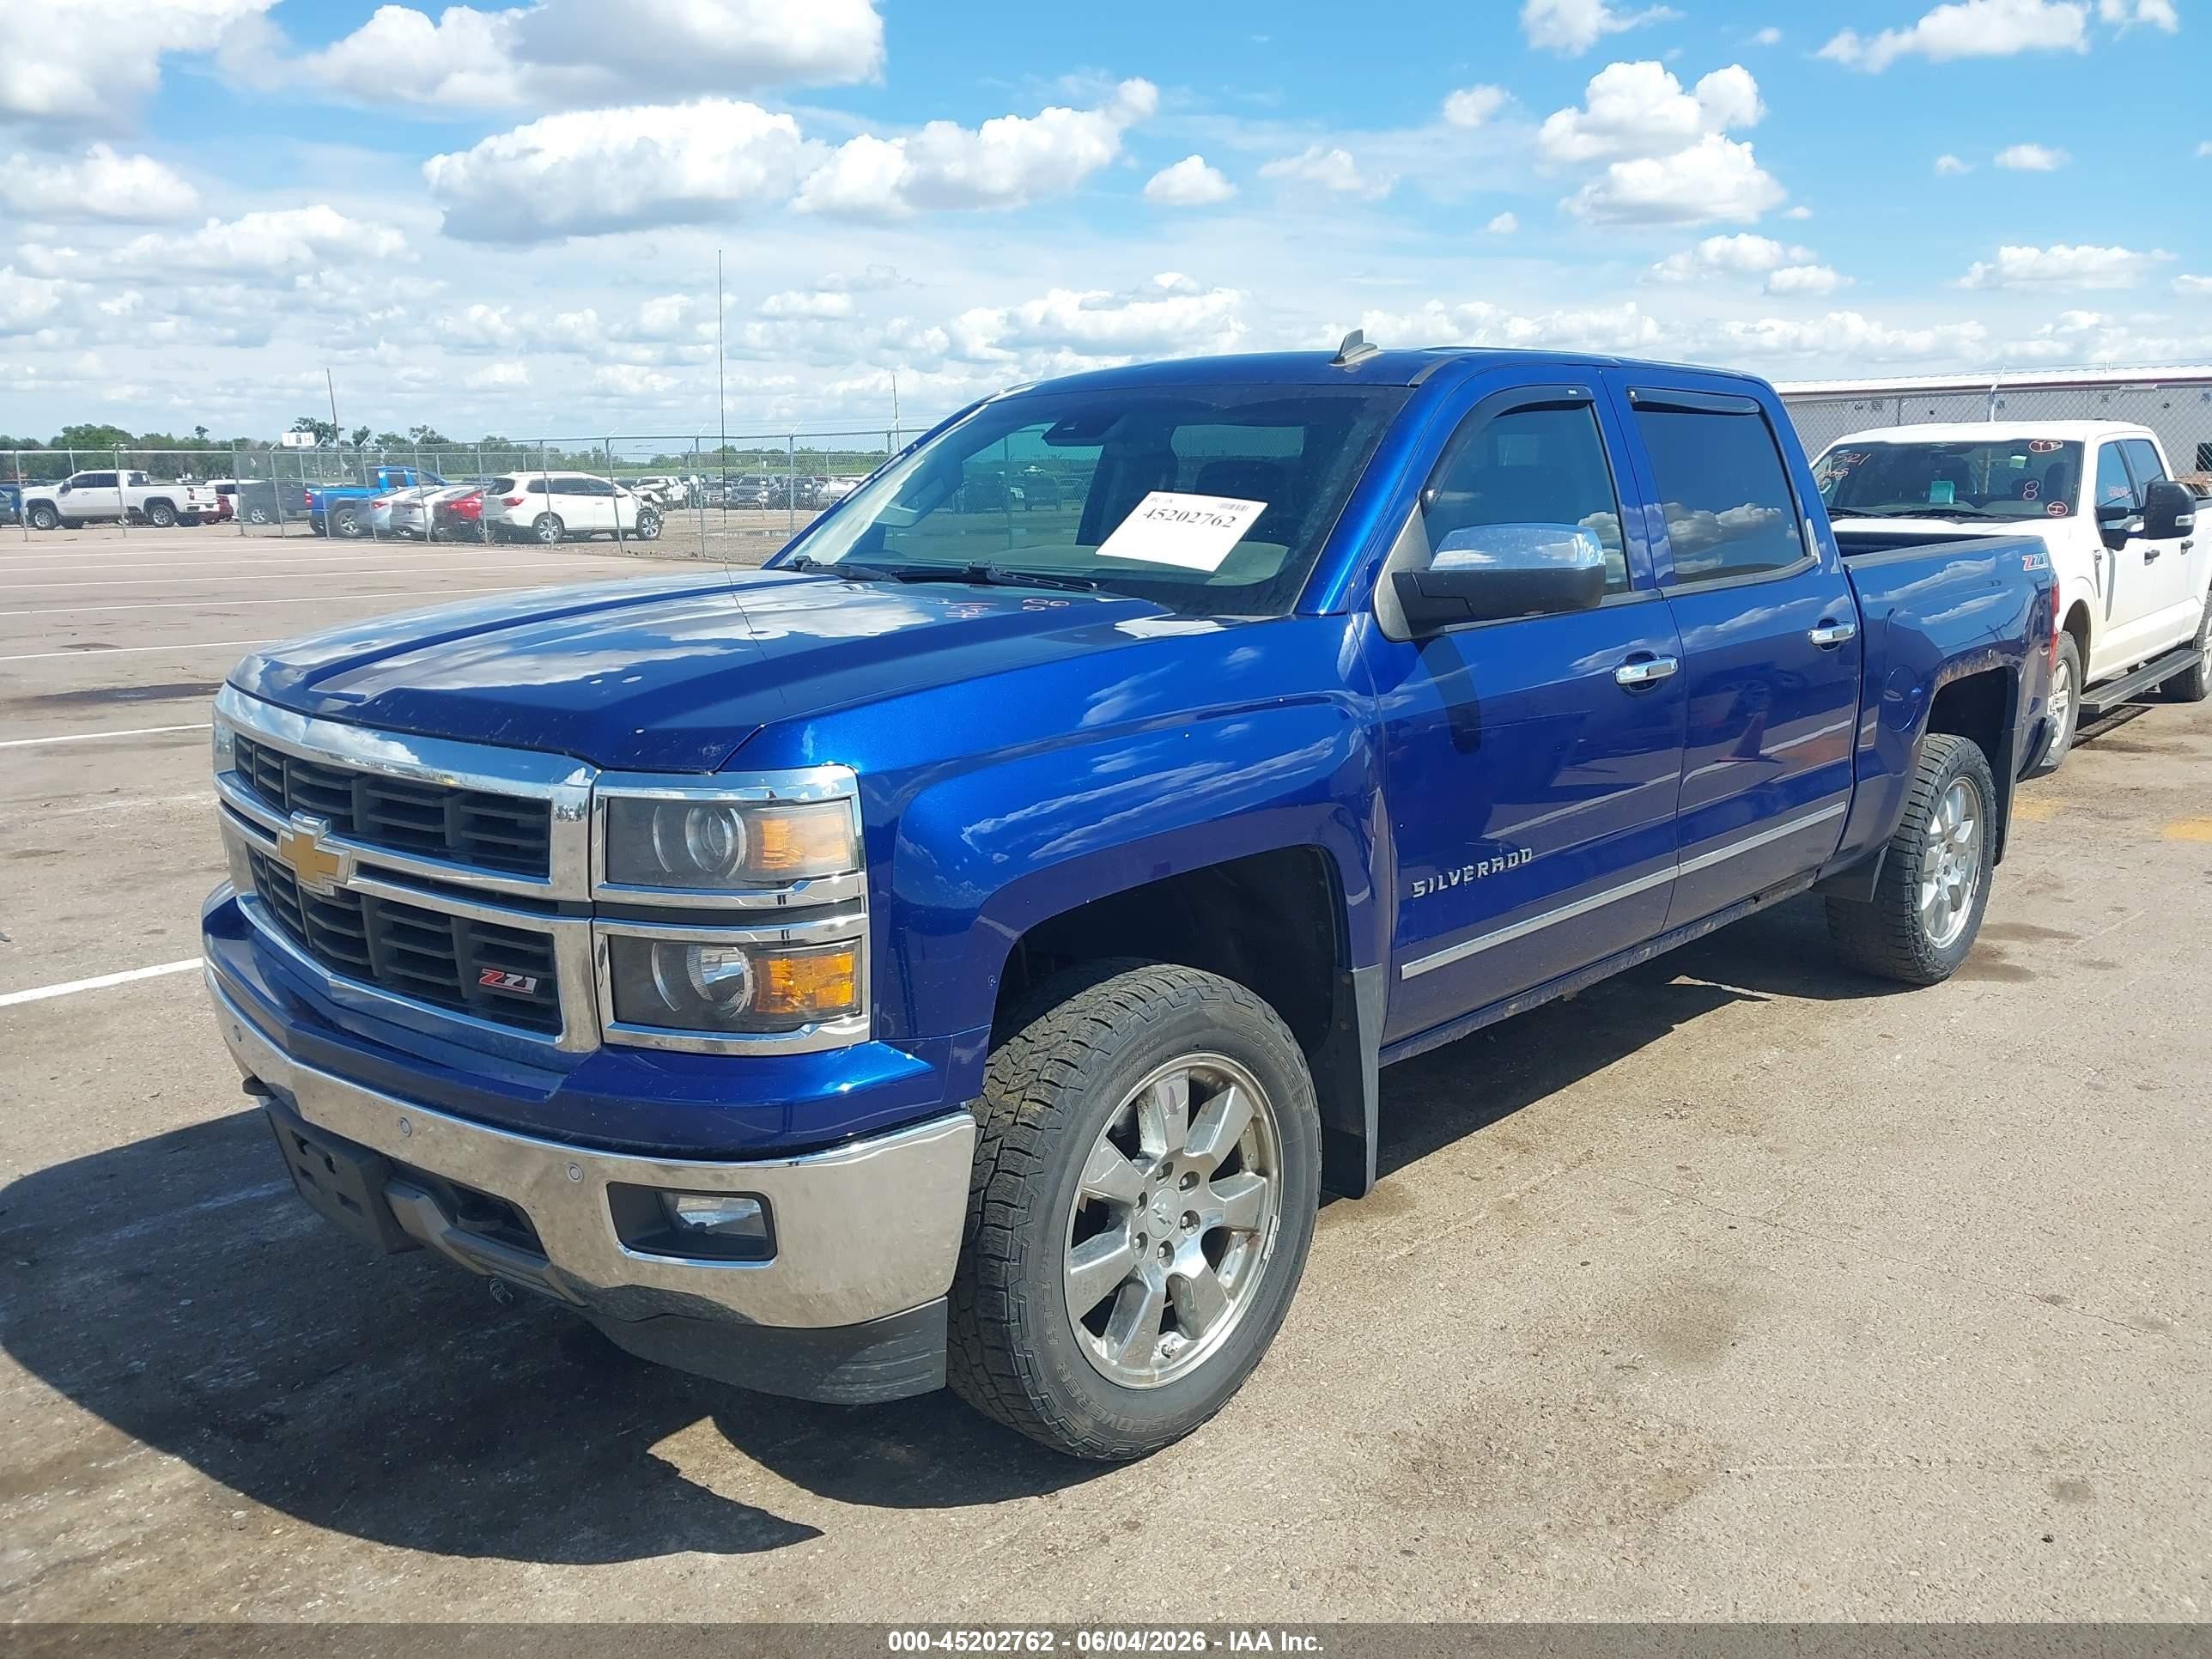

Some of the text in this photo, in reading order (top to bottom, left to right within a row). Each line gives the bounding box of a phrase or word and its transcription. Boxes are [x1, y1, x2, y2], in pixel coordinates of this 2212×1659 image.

[1143, 507, 1237, 528] 45202762
[2021, 552, 2048, 571] Z71
[1412, 847, 1533, 898] SILVERADO
[479, 968, 537, 994] Z71
